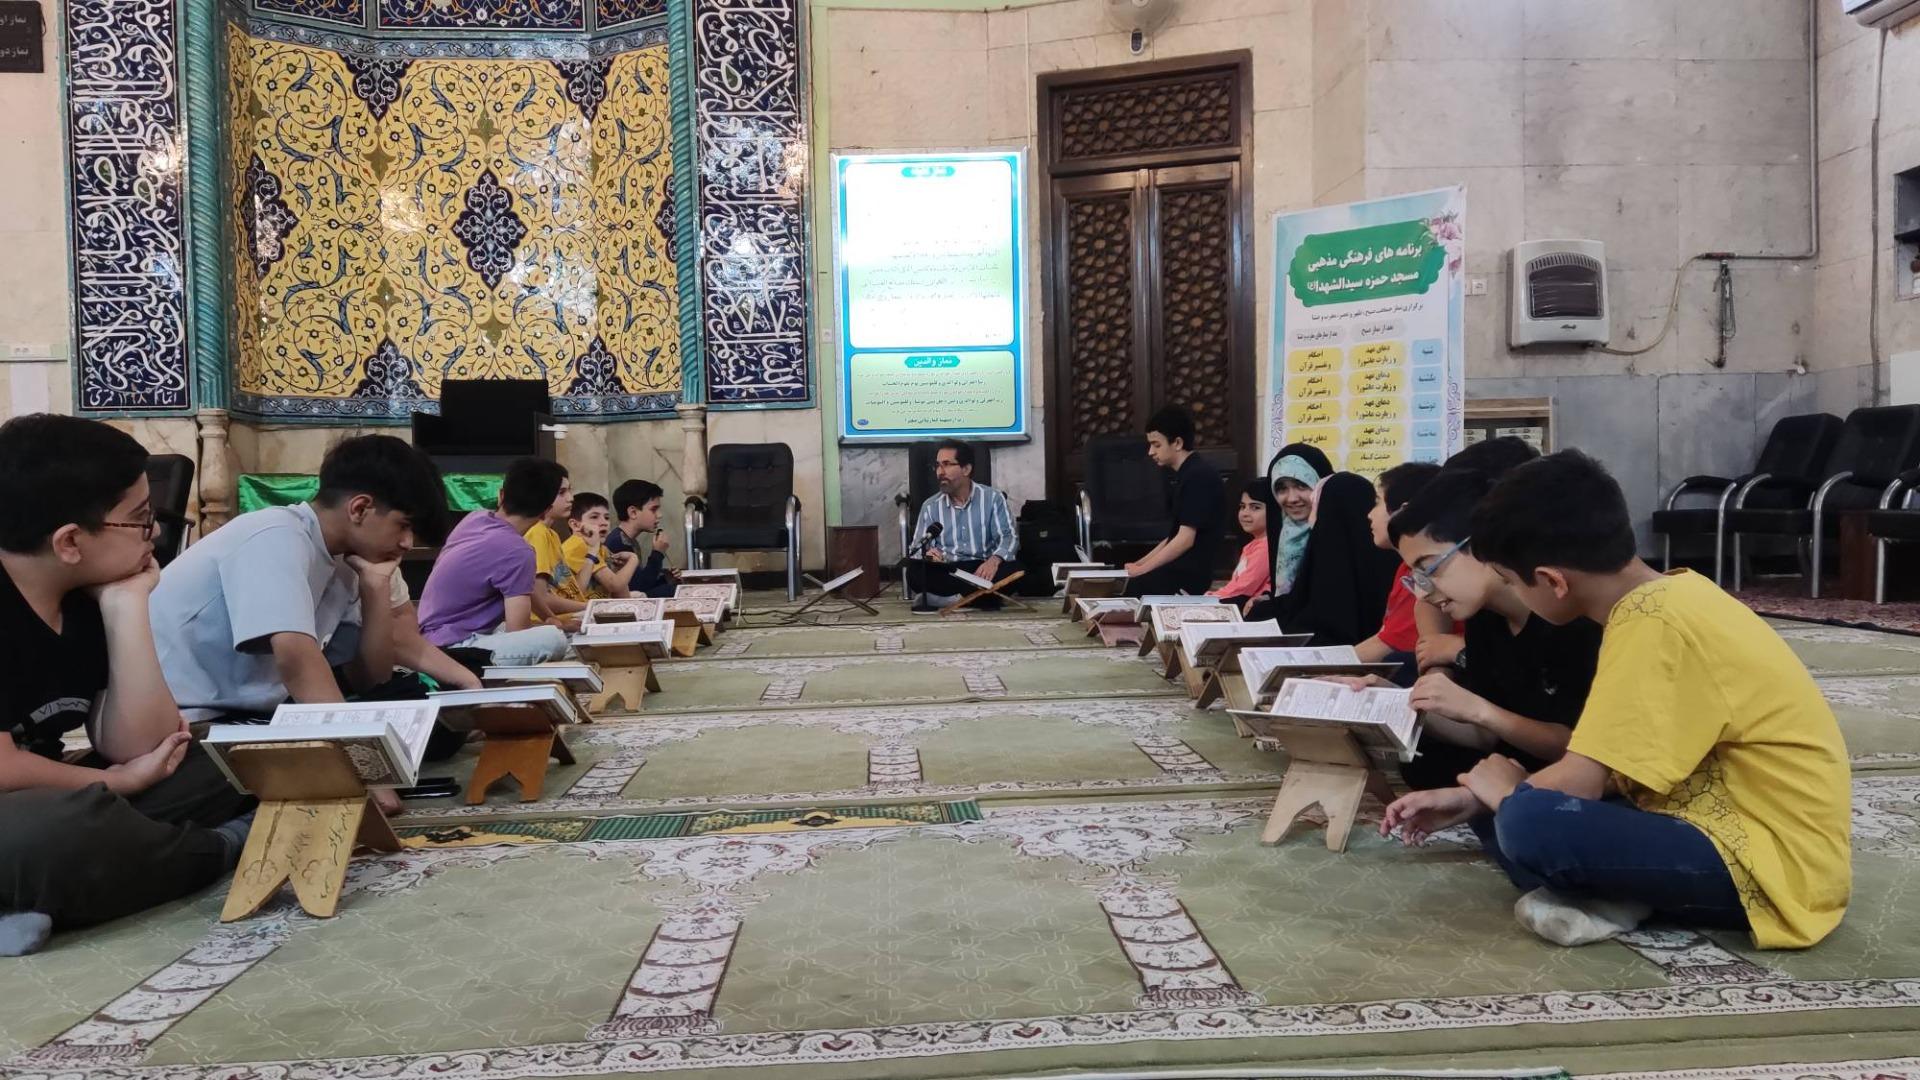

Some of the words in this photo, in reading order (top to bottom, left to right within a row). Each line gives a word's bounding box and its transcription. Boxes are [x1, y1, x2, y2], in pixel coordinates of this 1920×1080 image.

[1375, 246, 1394, 263] های
[1396, 243, 1422, 257] برنامه
[1308, 253, 1337, 272] مذهبی
[1339, 247, 1373, 268] فرهنگی
[1365, 275, 1388, 289] حمزه
[1391, 271, 1419, 285] مسجد
[1376, 345, 1390, 353] دعای
[1308, 350, 1323, 359] احکام
[1307, 376, 1322, 385] احکام
[1375, 372, 1390, 380] دعای
[1306, 403, 1322, 411] احکام
[1375, 398, 1390, 407] دعای
[1375, 425, 1390, 435] دعای
